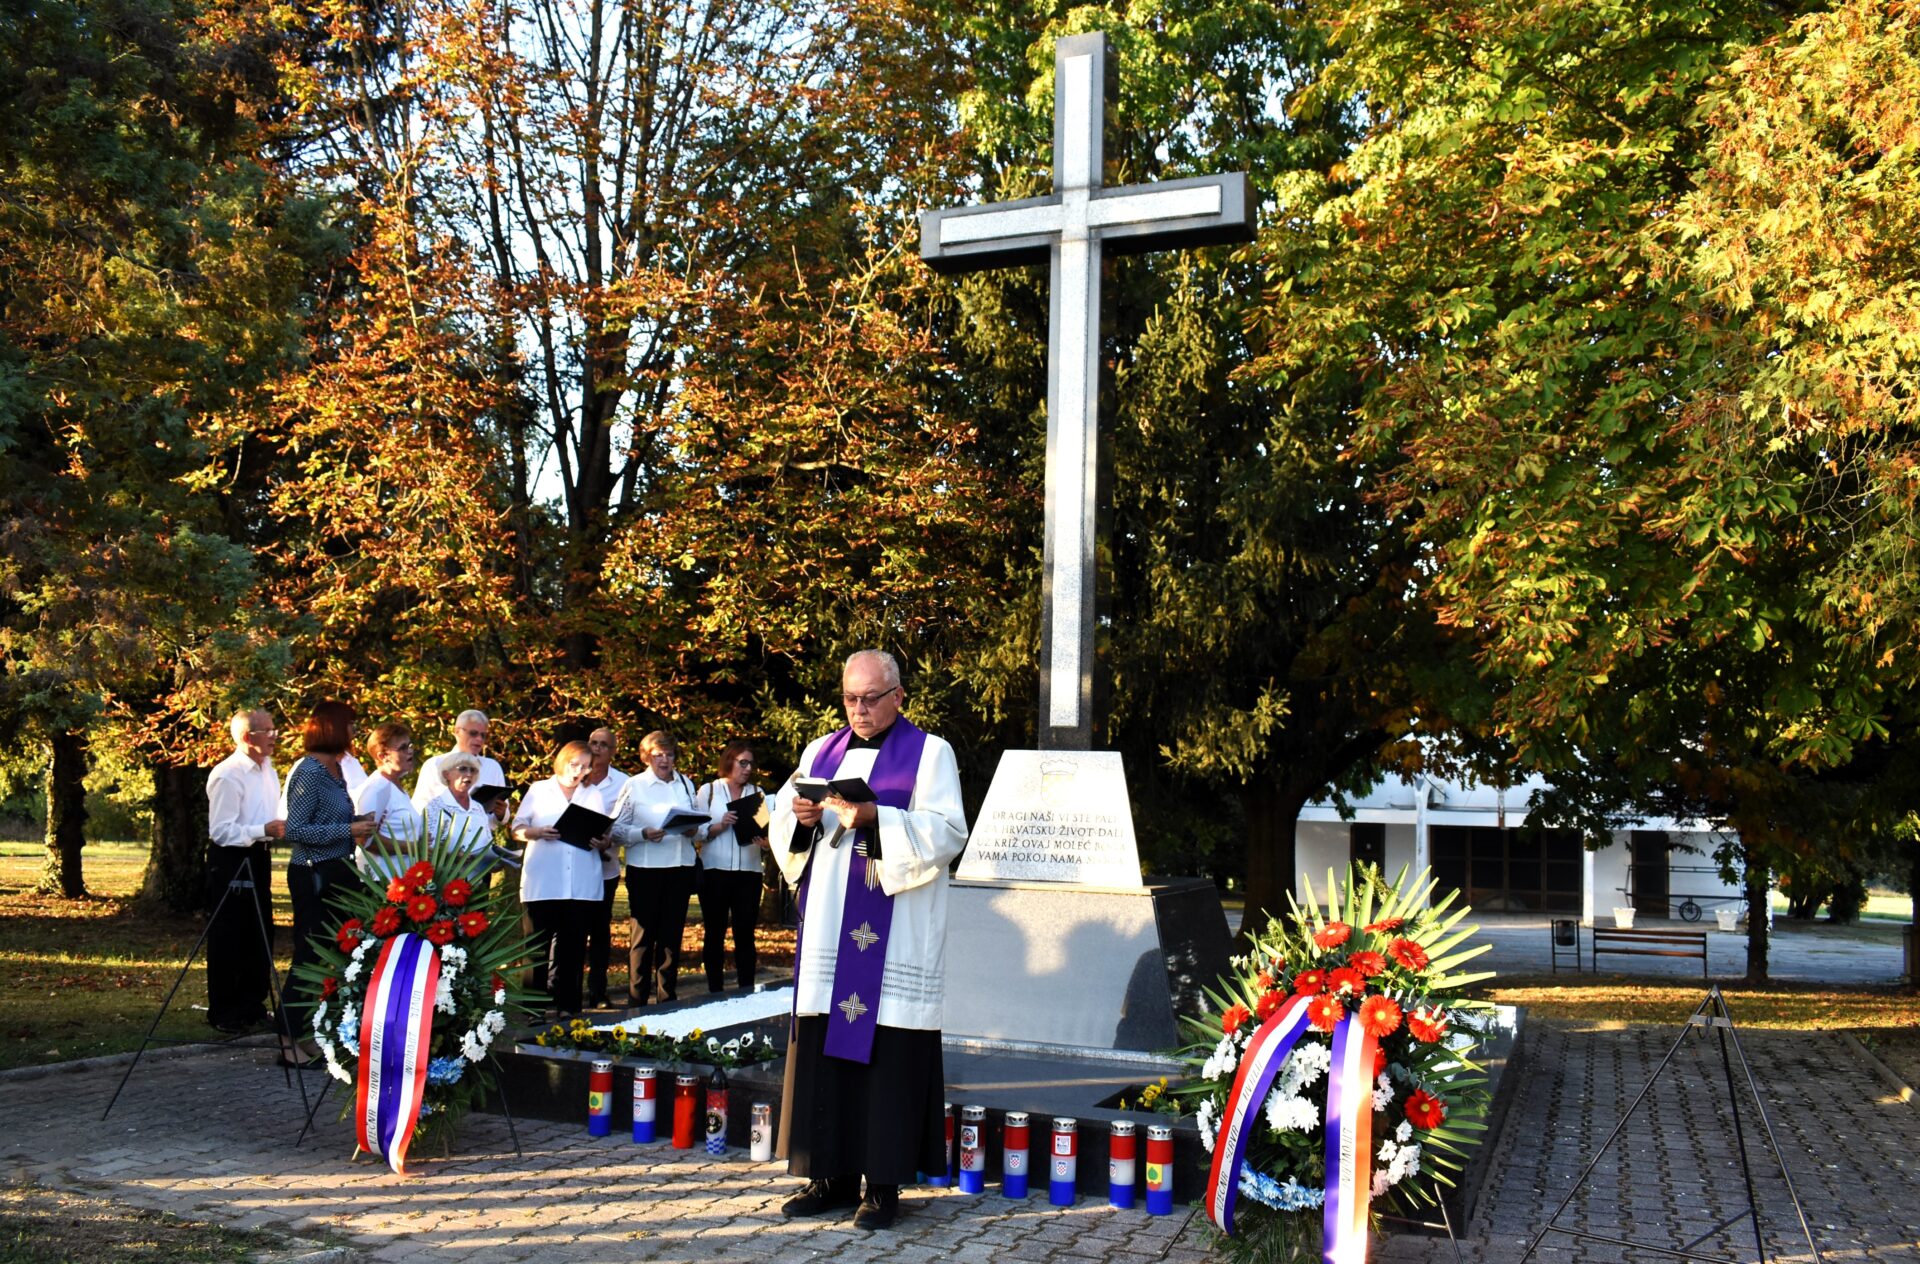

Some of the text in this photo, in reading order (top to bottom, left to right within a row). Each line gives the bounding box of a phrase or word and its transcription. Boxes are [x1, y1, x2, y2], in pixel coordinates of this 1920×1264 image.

[992, 811, 1027, 821] DRAGI
[1030, 811, 1055, 822] NAŠI
[1059, 813, 1069, 822] VI
[1073, 813, 1091, 823] STE
[1002, 825, 1056, 835] HRVATSKU
[1059, 825, 1095, 837] ŽIVOT
[1098, 828, 1124, 838] DALI
[995, 837, 1019, 848] KRIŽ
[1022, 839, 1050, 849] OVAJ
[1054, 840, 1092, 850] MOLEĆ
[978, 850, 1008, 861] VAMA
[1012, 852, 1047, 863] POKOJ
[1050, 854, 1082, 864] NAMA
[370, 1070, 380, 1101] SLAVA
[365, 1110, 377, 1145] VJEČNA
[1215, 1170, 1228, 1212] VJEČNA
[1225, 1124, 1239, 1164] SLAVA
